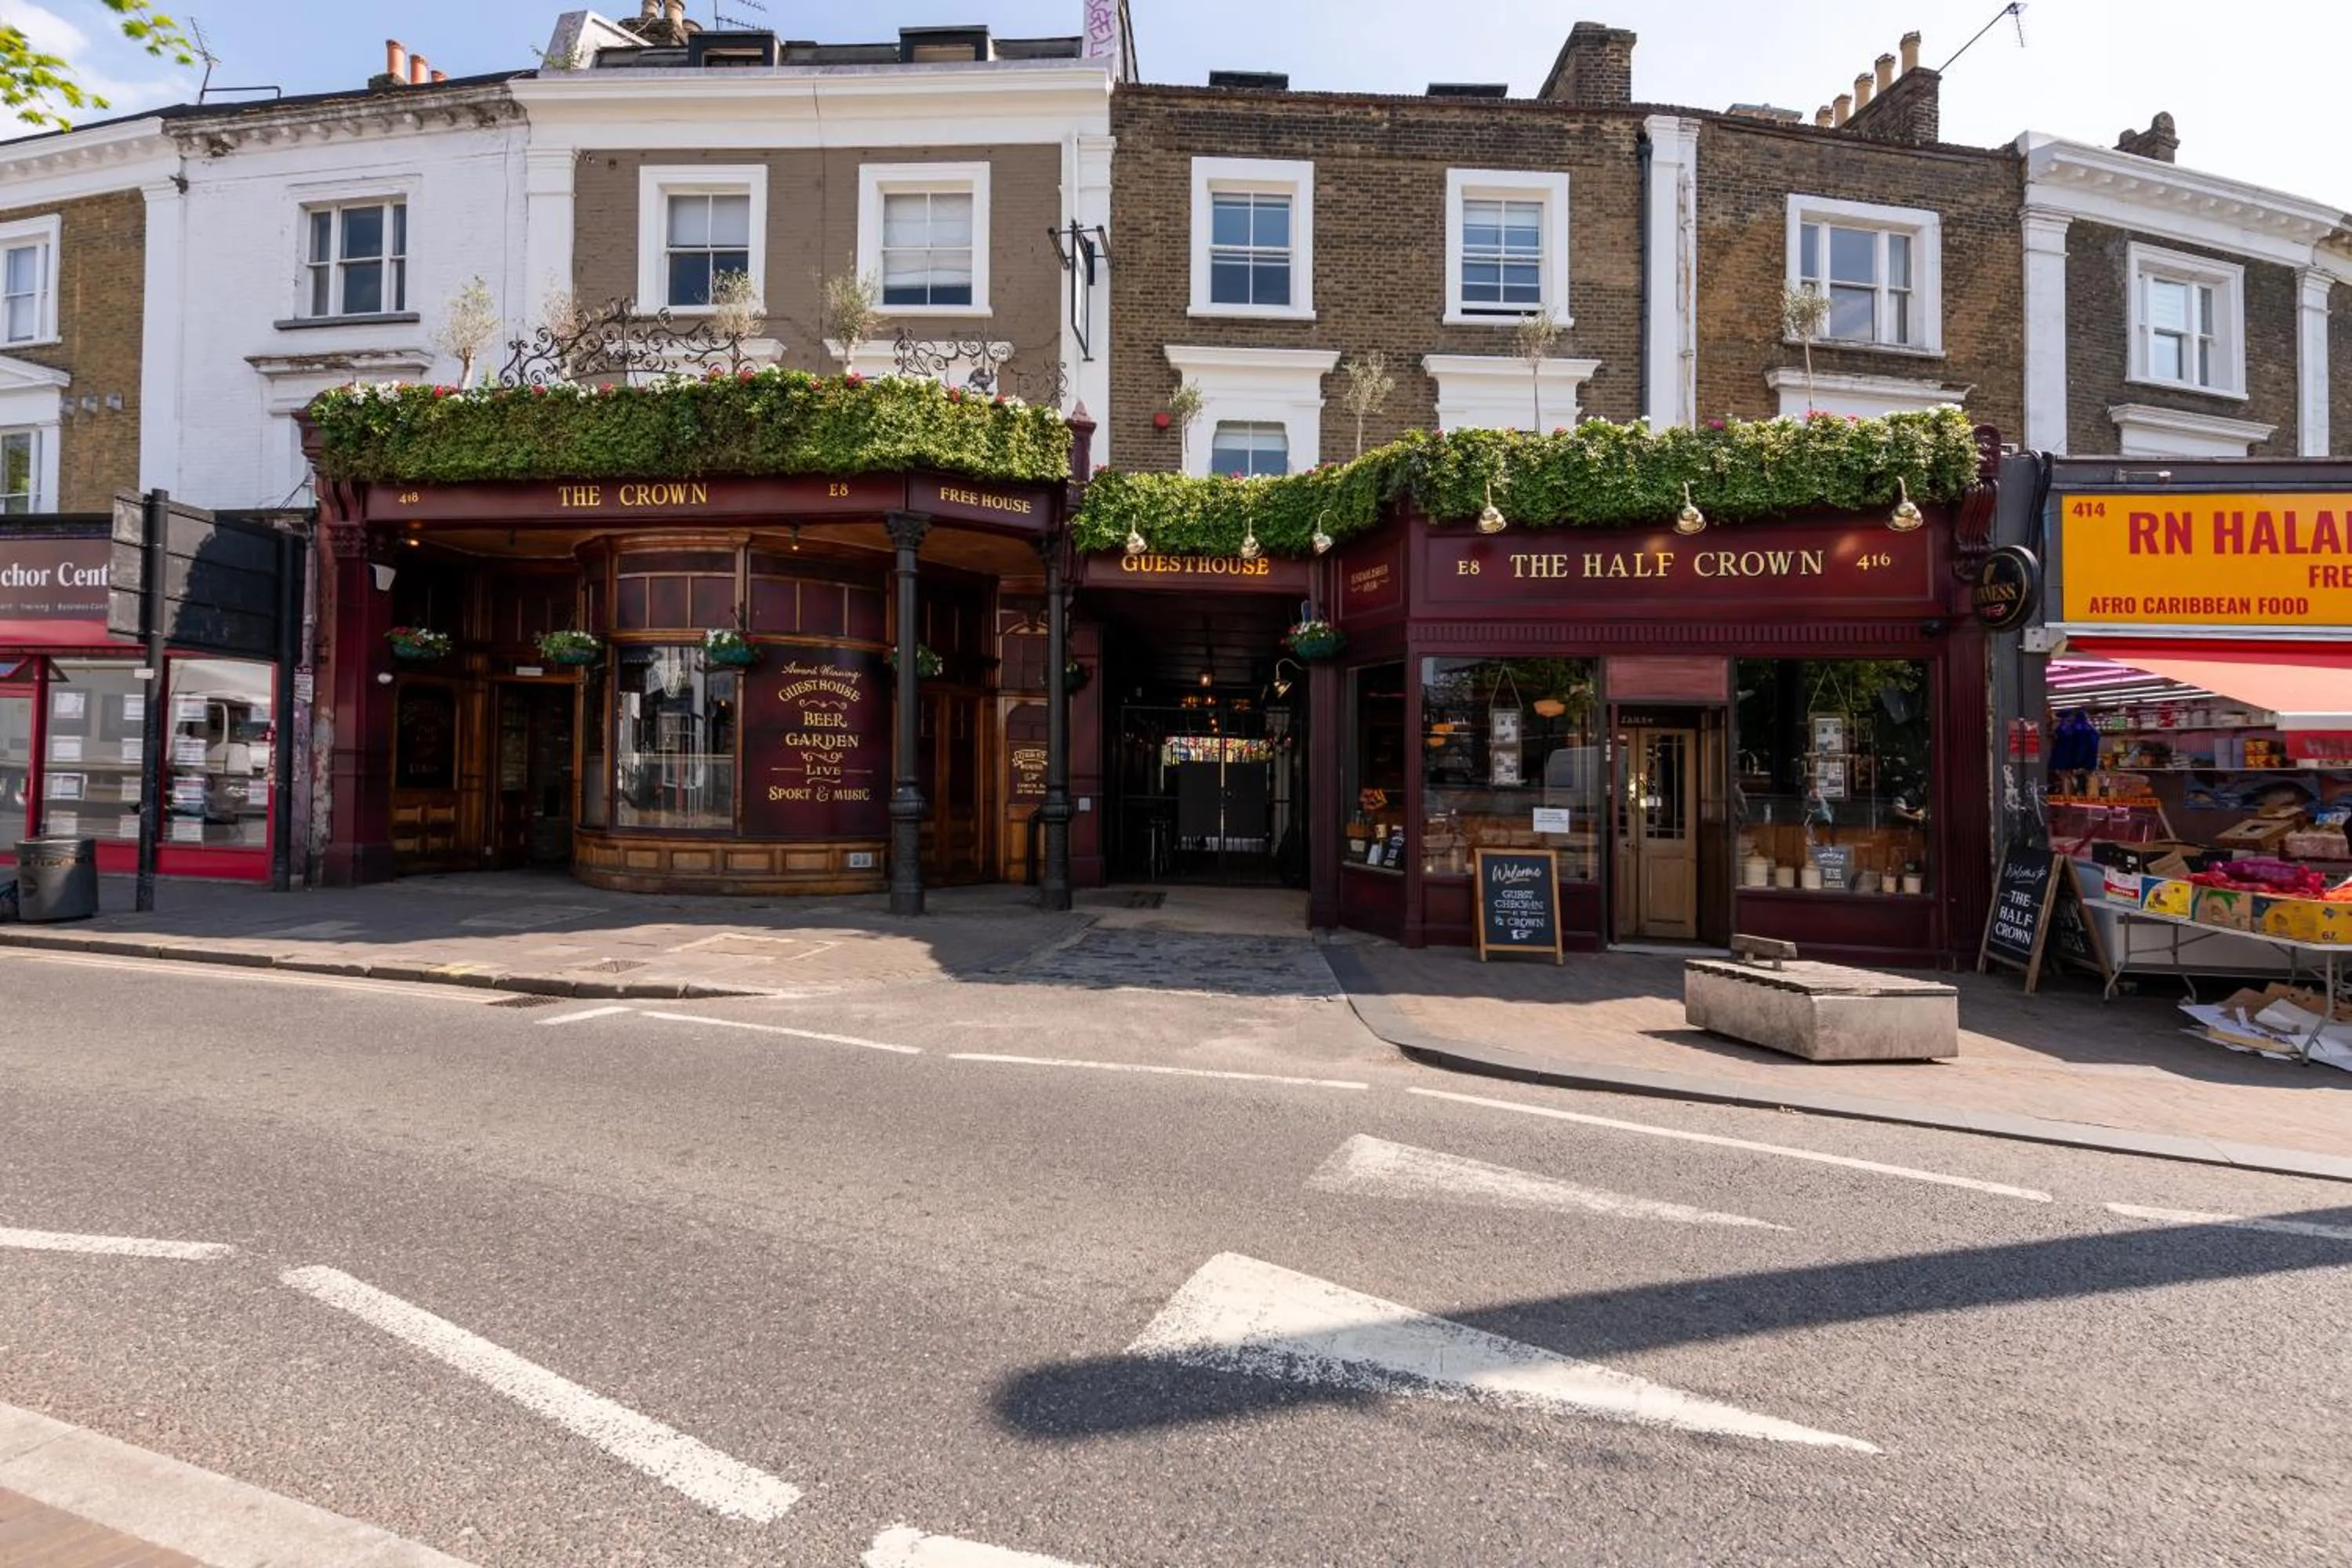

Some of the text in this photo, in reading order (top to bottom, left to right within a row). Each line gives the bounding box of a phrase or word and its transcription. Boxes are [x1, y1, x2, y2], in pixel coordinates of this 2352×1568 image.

[398, 492, 419, 504] 418
[558, 484, 707, 506] THE CROWN
[829, 483, 849, 496] E8
[941, 487, 1032, 514] FREE HOUSE
[2073, 502, 2106, 517] 414
[2129, 511, 2193, 554] RN
[1122, 554, 1269, 575] GUESTHOUSE
[1457, 560, 1480, 575] E8
[1510, 550, 1824, 578] THE HALF CROWN
[1857, 554, 1892, 571] 416
[1, 561, 108, 586] chor Cent
[2309, 564, 2352, 588] FRE
[2089, 597, 2309, 615] AFRO CARIBBEAN FOOD
[782, 660, 861, 684] Award Winning
[779, 679, 861, 702] GUESTHOUSE
[804, 711, 848, 728] BEER
[786, 732, 858, 750] GARDEN
[816, 785, 829, 802] &
[833, 788, 869, 800] MUSIC
[1501, 890, 1534, 899] GUEST
[2010, 890, 2032, 907] THE
[1507, 917, 1544, 927] CROWN
[1999, 906, 2033, 927] HALF
[1995, 922, 2033, 945] CROWN
